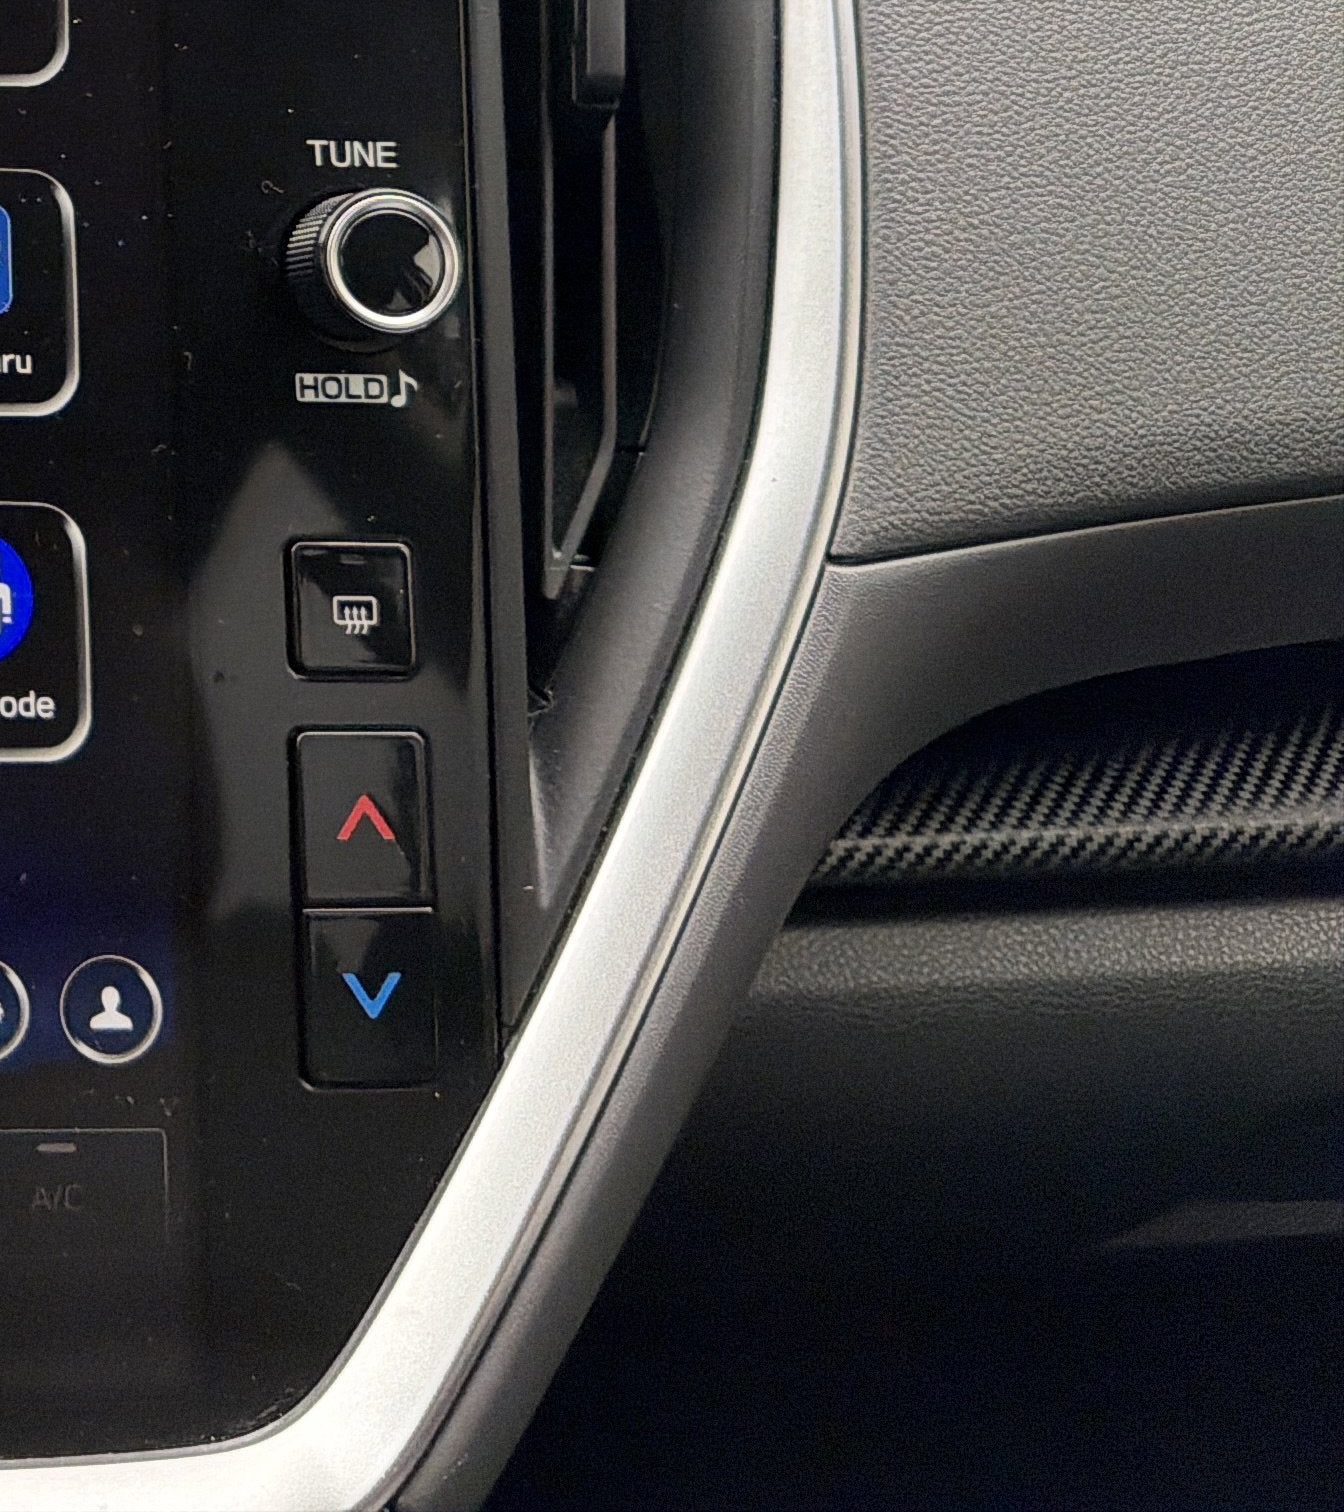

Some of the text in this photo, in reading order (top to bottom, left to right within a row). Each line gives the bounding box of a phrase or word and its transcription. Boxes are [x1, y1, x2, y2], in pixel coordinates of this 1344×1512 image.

[306, 139, 398, 168] TUNE
[298, 376, 385, 400] HOLD
[32, 1185, 82, 1211] A/C
